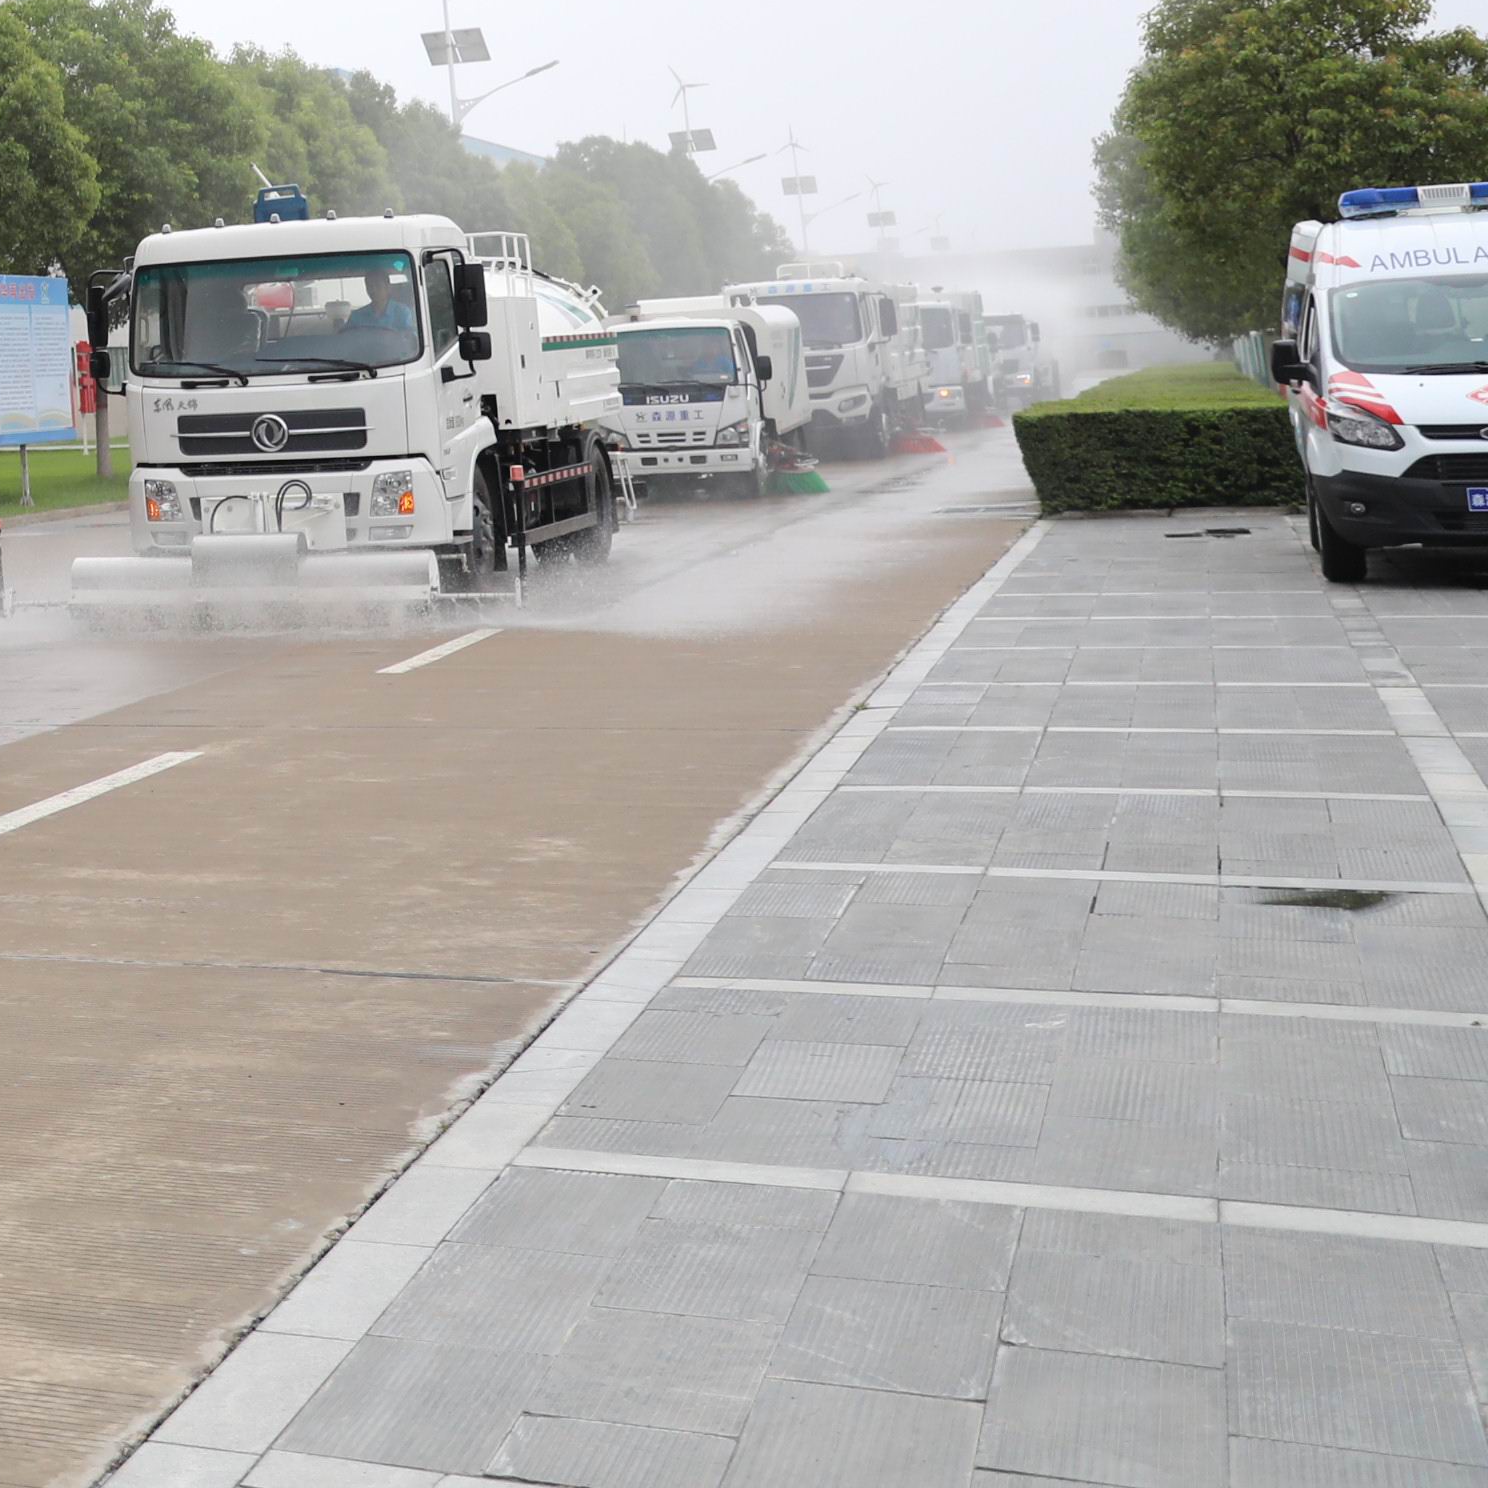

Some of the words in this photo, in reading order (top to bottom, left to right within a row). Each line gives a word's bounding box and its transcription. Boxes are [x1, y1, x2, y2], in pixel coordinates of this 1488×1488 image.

[646, 394, 689, 405] ISUZU
[652, 410, 704, 422] 森源重工
